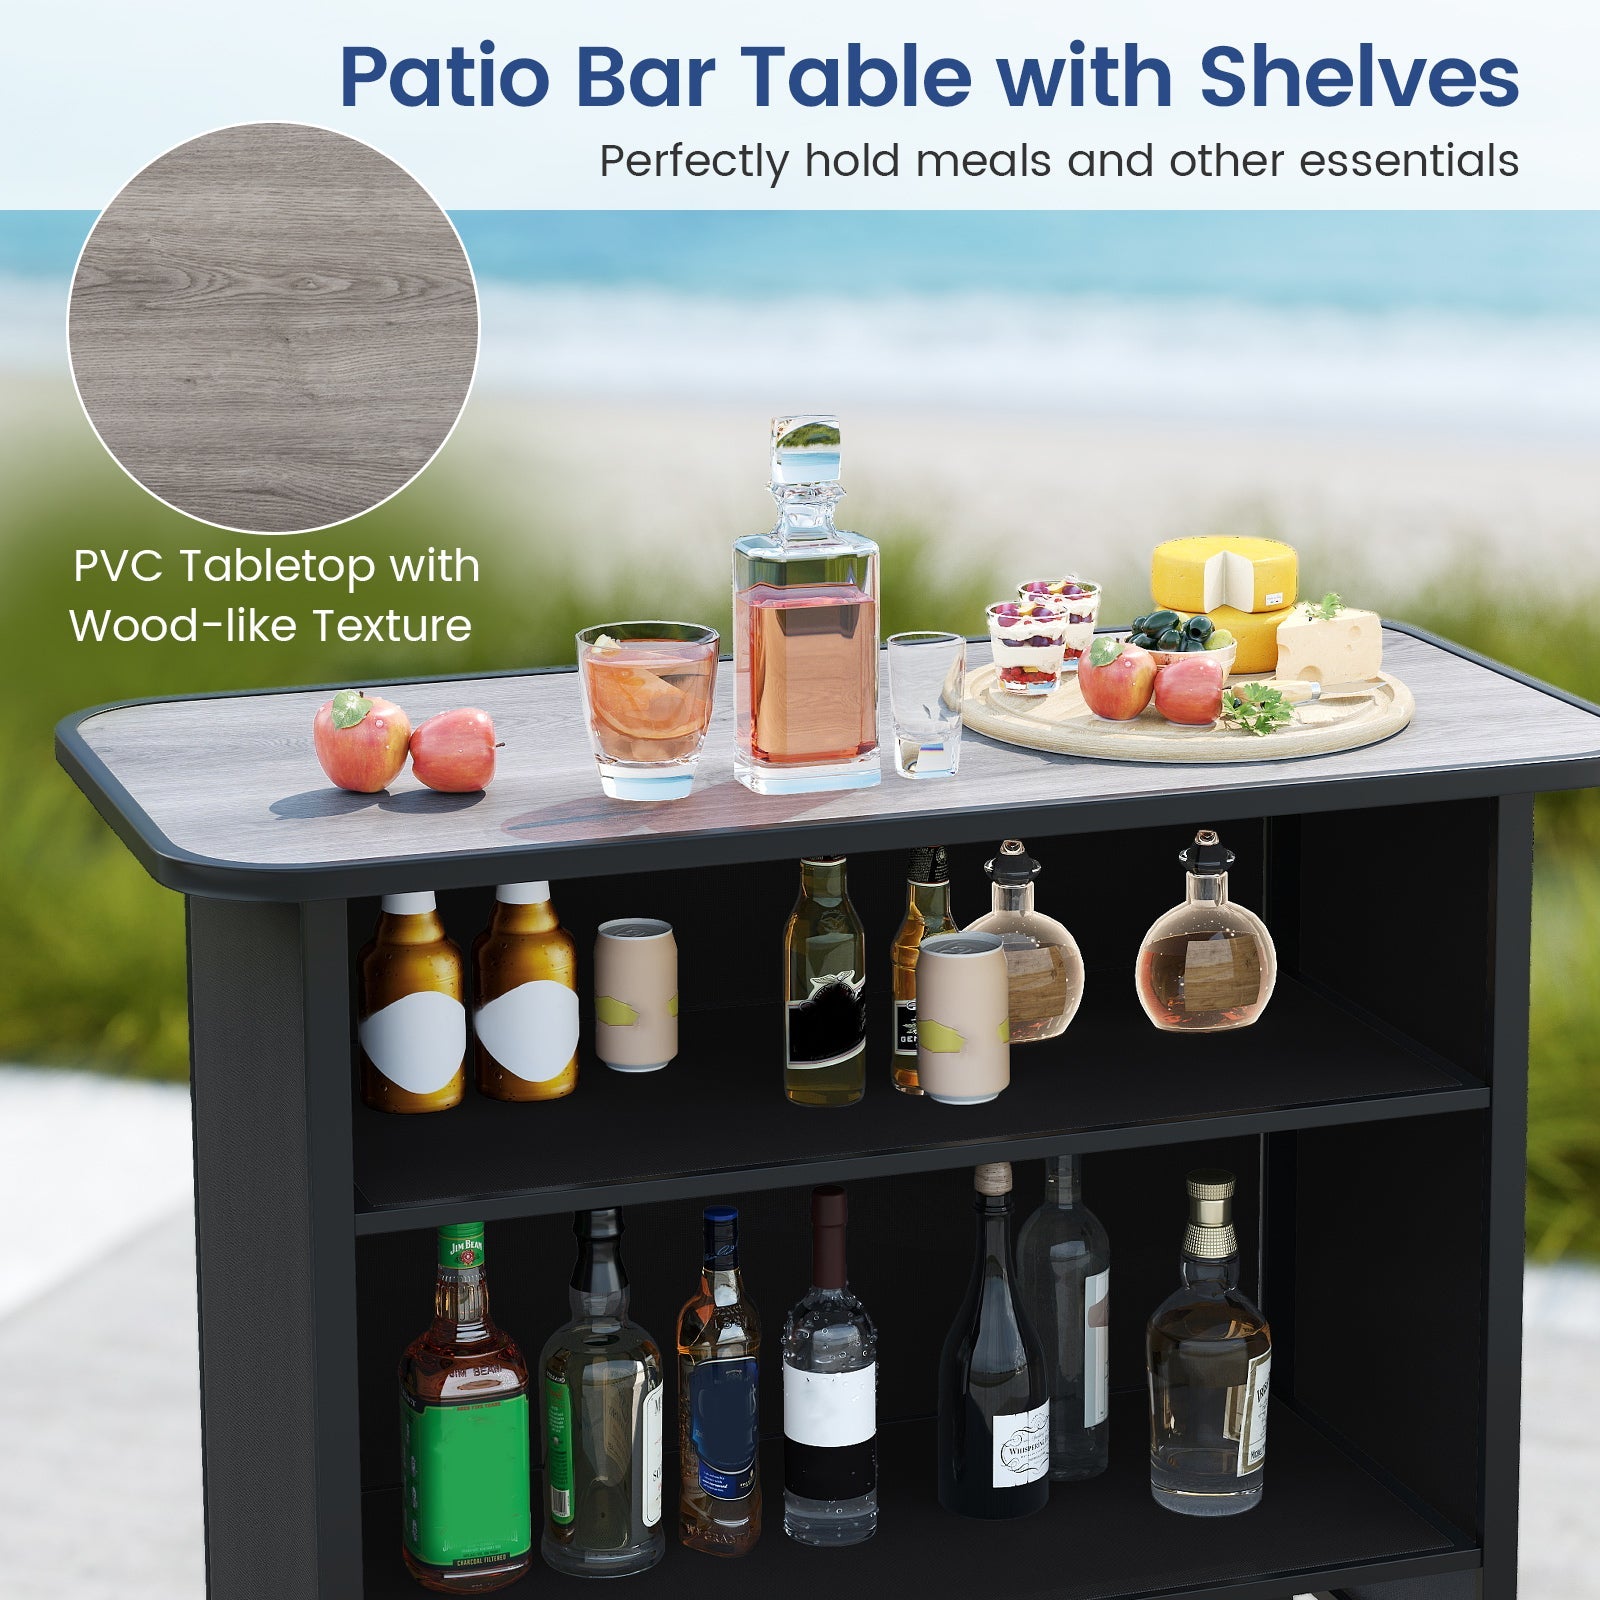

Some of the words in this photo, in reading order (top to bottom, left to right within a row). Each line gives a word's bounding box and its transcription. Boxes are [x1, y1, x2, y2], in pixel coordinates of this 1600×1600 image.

[450, 1243, 464, 1255] JIM
[449, 1368, 467, 1378] JIM
[457, 1559, 483, 1567] CHARCOAL
[484, 1553, 507, 1563] FILTERED
